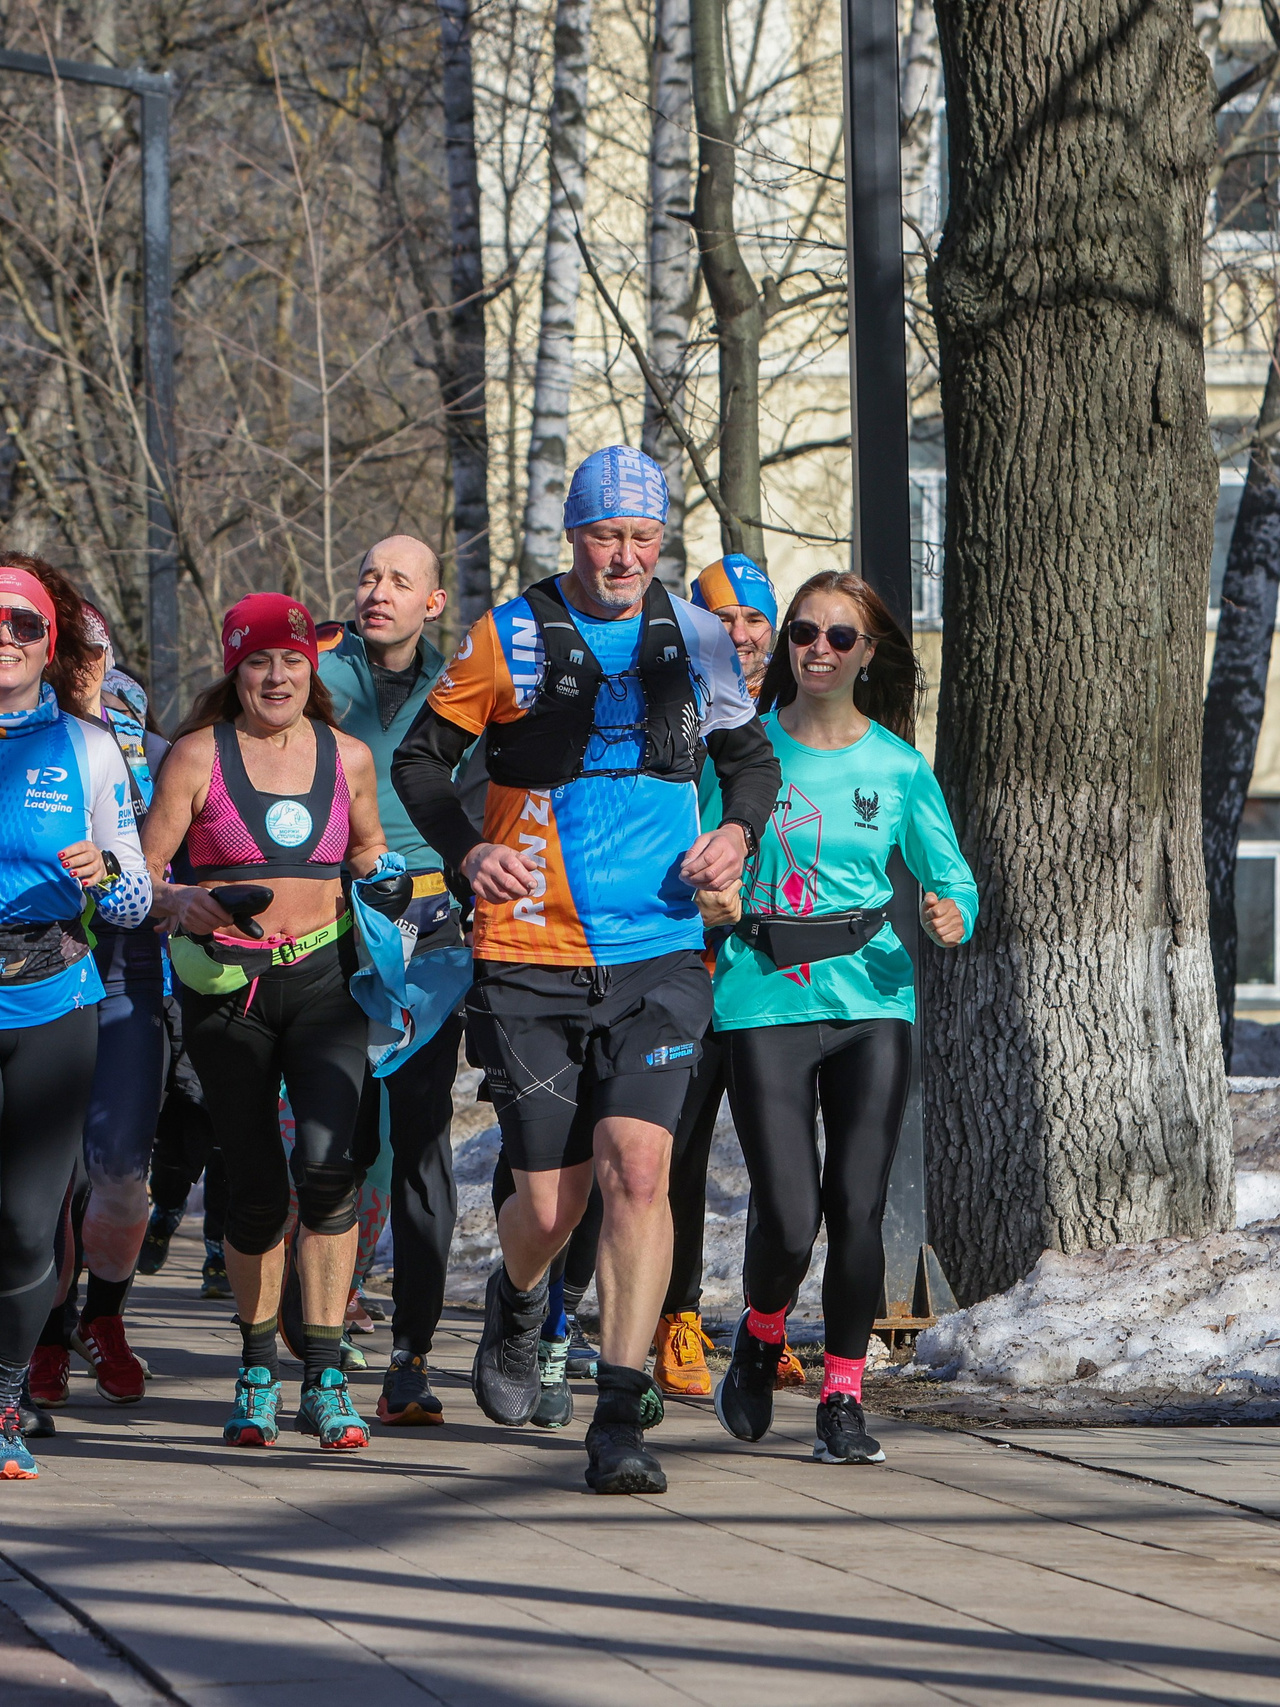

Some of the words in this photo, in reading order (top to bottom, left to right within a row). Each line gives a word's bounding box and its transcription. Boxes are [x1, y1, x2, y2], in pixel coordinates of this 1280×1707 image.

[603, 487, 615, 509] club
[643, 463, 665, 521] RUN
[25, 788, 69, 802] Natalya
[24, 799, 73, 813] Ladygina
[118, 808, 132, 819] RUN
[117, 817, 136, 829] ZEPP
